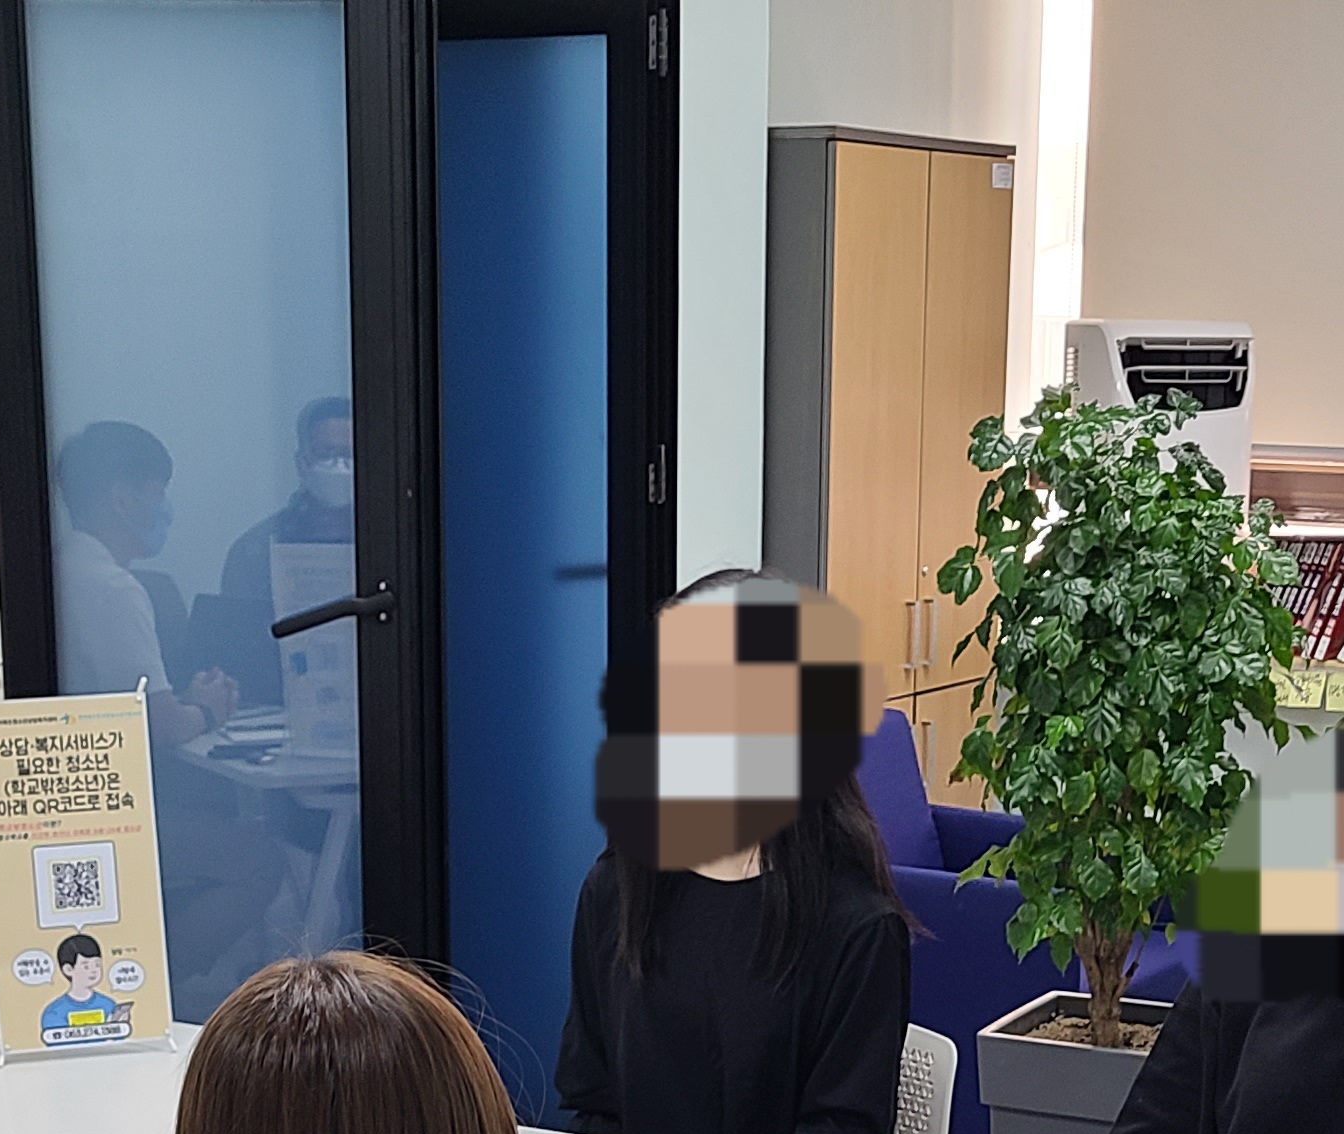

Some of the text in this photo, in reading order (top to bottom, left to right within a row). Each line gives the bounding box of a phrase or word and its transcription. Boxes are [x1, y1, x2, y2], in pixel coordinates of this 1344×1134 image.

[16, 753, 110, 776] 필요한 청소년
[4, 772, 121, 797] (학교밖청소년)은
[32, 794, 102, 815] QR코드로
[106, 792, 135, 811] 접속
